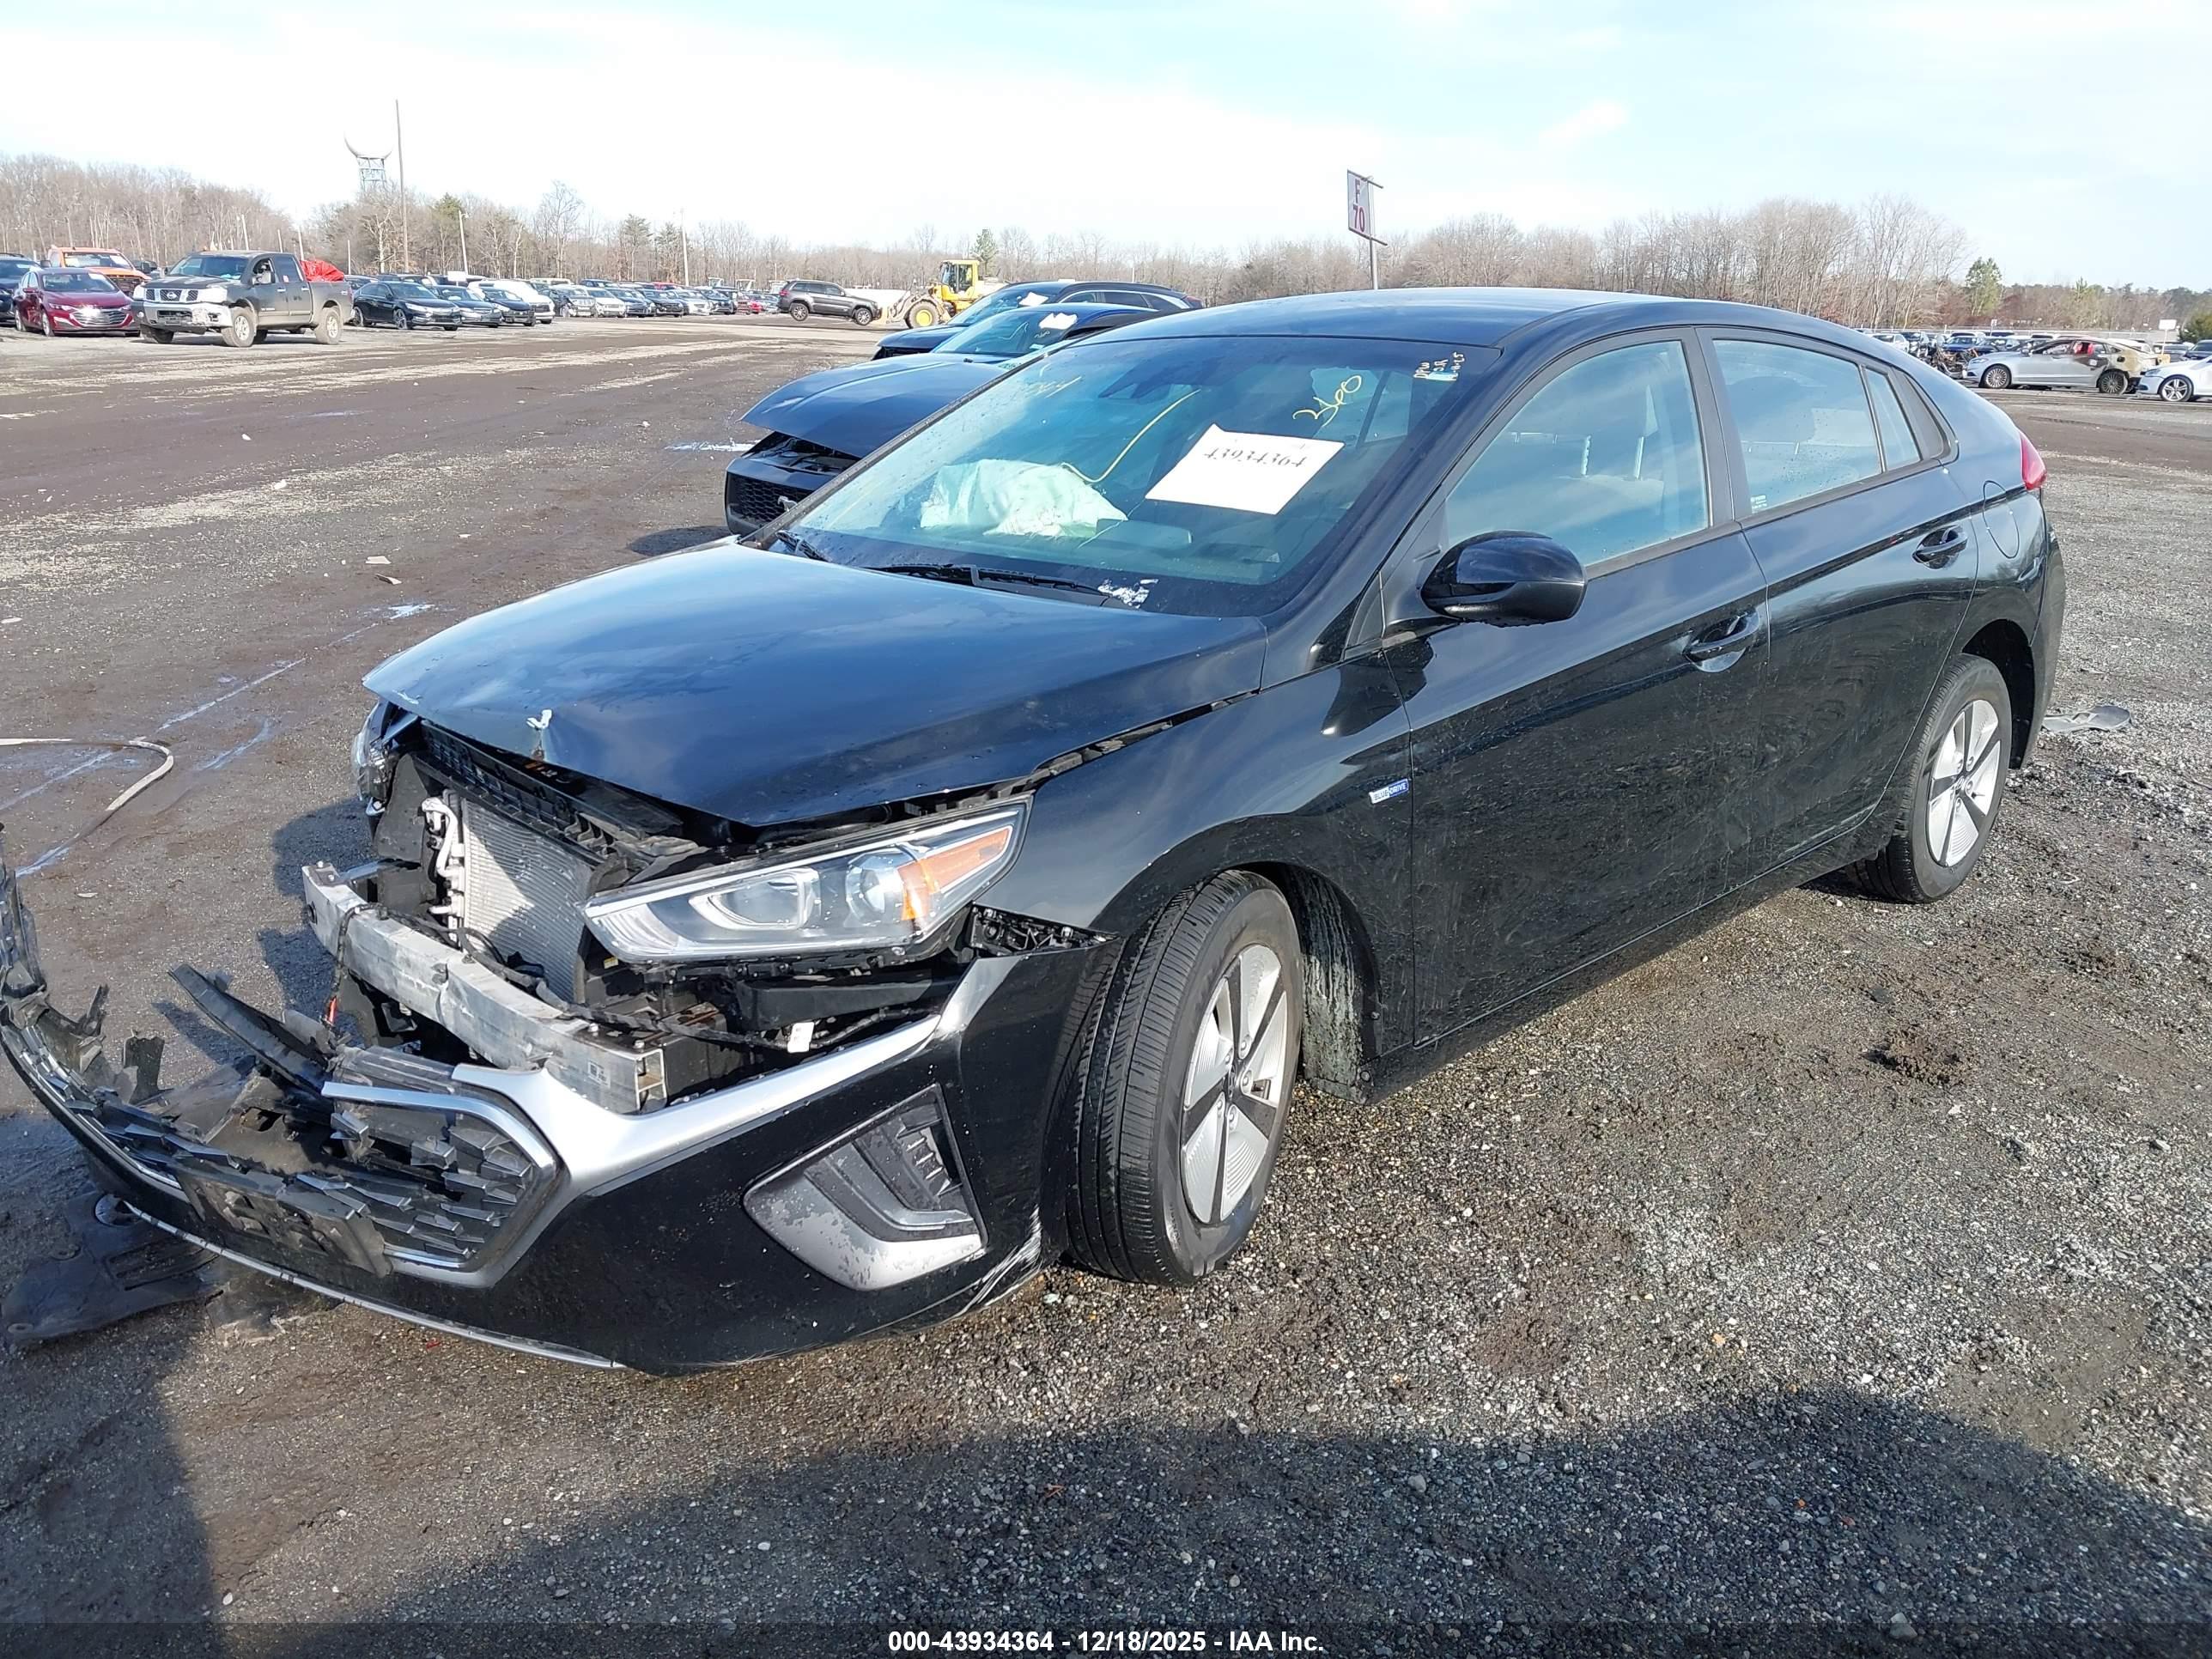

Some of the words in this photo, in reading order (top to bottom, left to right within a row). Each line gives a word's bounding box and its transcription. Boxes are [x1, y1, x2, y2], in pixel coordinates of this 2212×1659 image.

[1354, 178, 1360, 204] F
[1352, 204, 1365, 233] 70
[1204, 447, 1308, 467] 43934364
